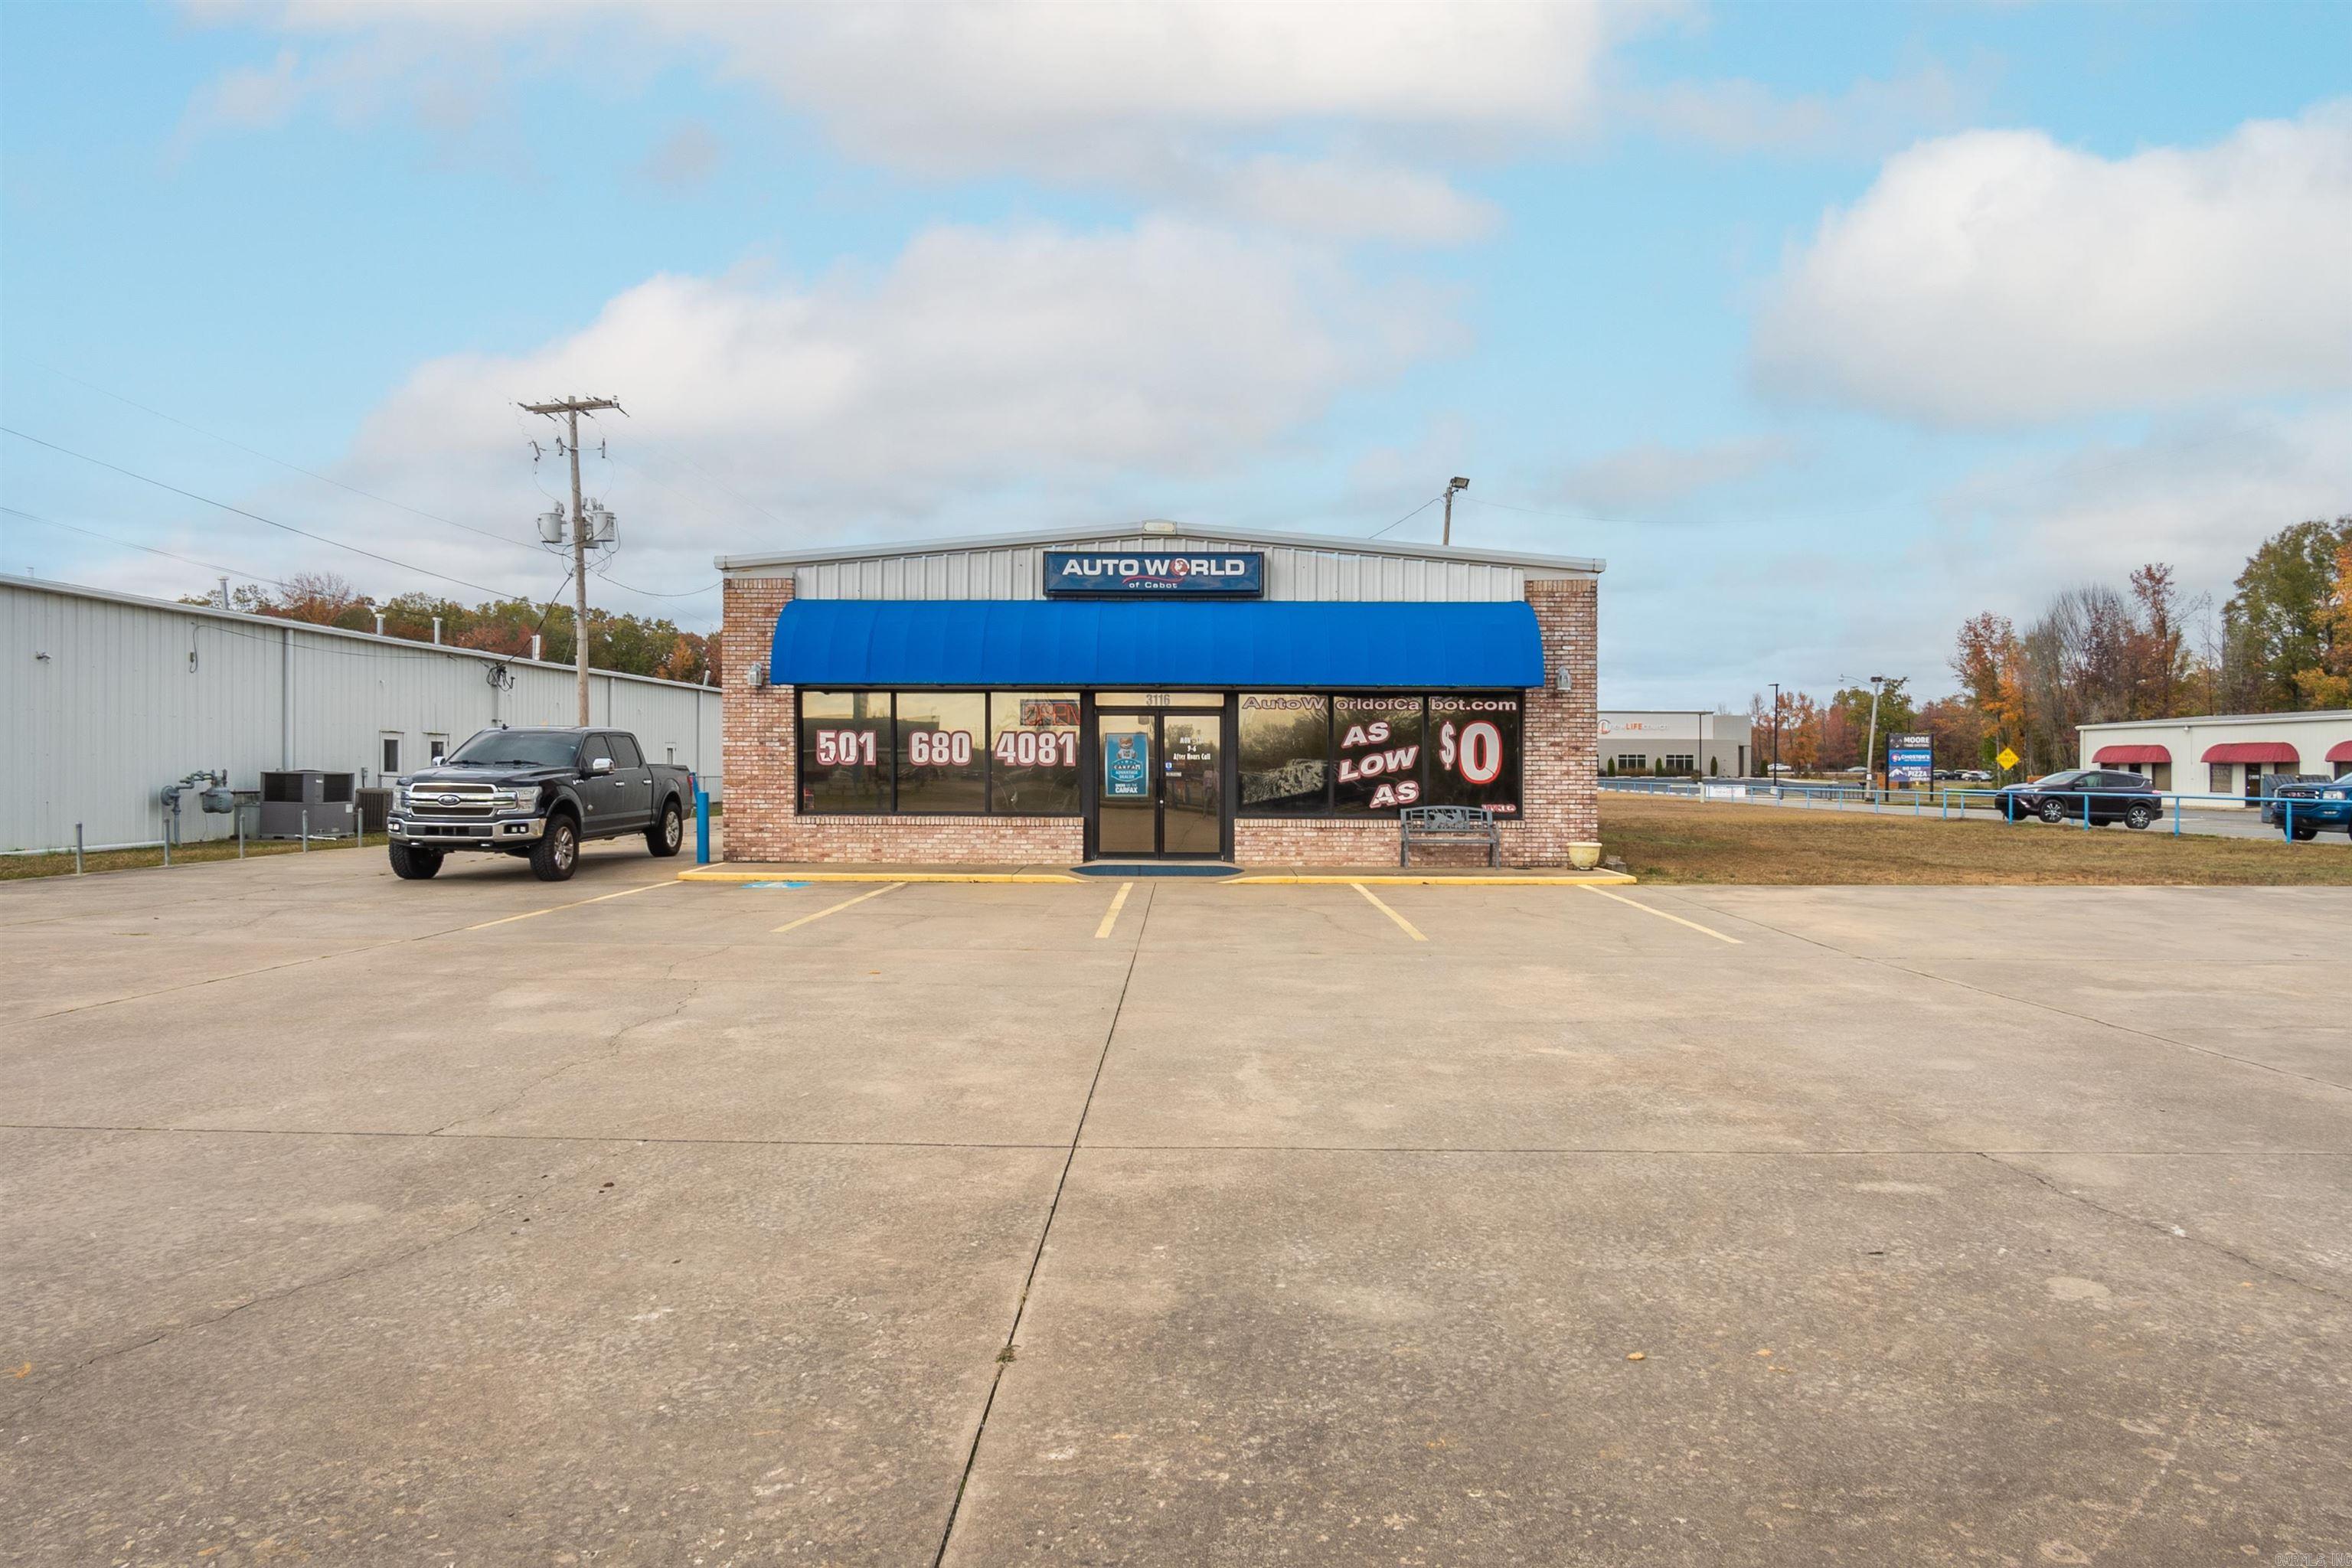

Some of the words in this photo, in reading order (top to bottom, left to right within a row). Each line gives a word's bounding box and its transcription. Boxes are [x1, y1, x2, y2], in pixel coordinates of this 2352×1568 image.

[1062, 559, 1139, 576] AUTO
[1145, 558, 1245, 576] WORLD
[1145, 694, 1171, 706] 3116
[816, 729, 877, 766] 501
[909, 730, 973, 766] 680
[995, 730, 1076, 766] 4081
[1341, 721, 1390, 749] AS
[1338, 745, 1419, 782] LOW
[1439, 720, 1503, 785] $0
[1369, 780, 1419, 808] AS
